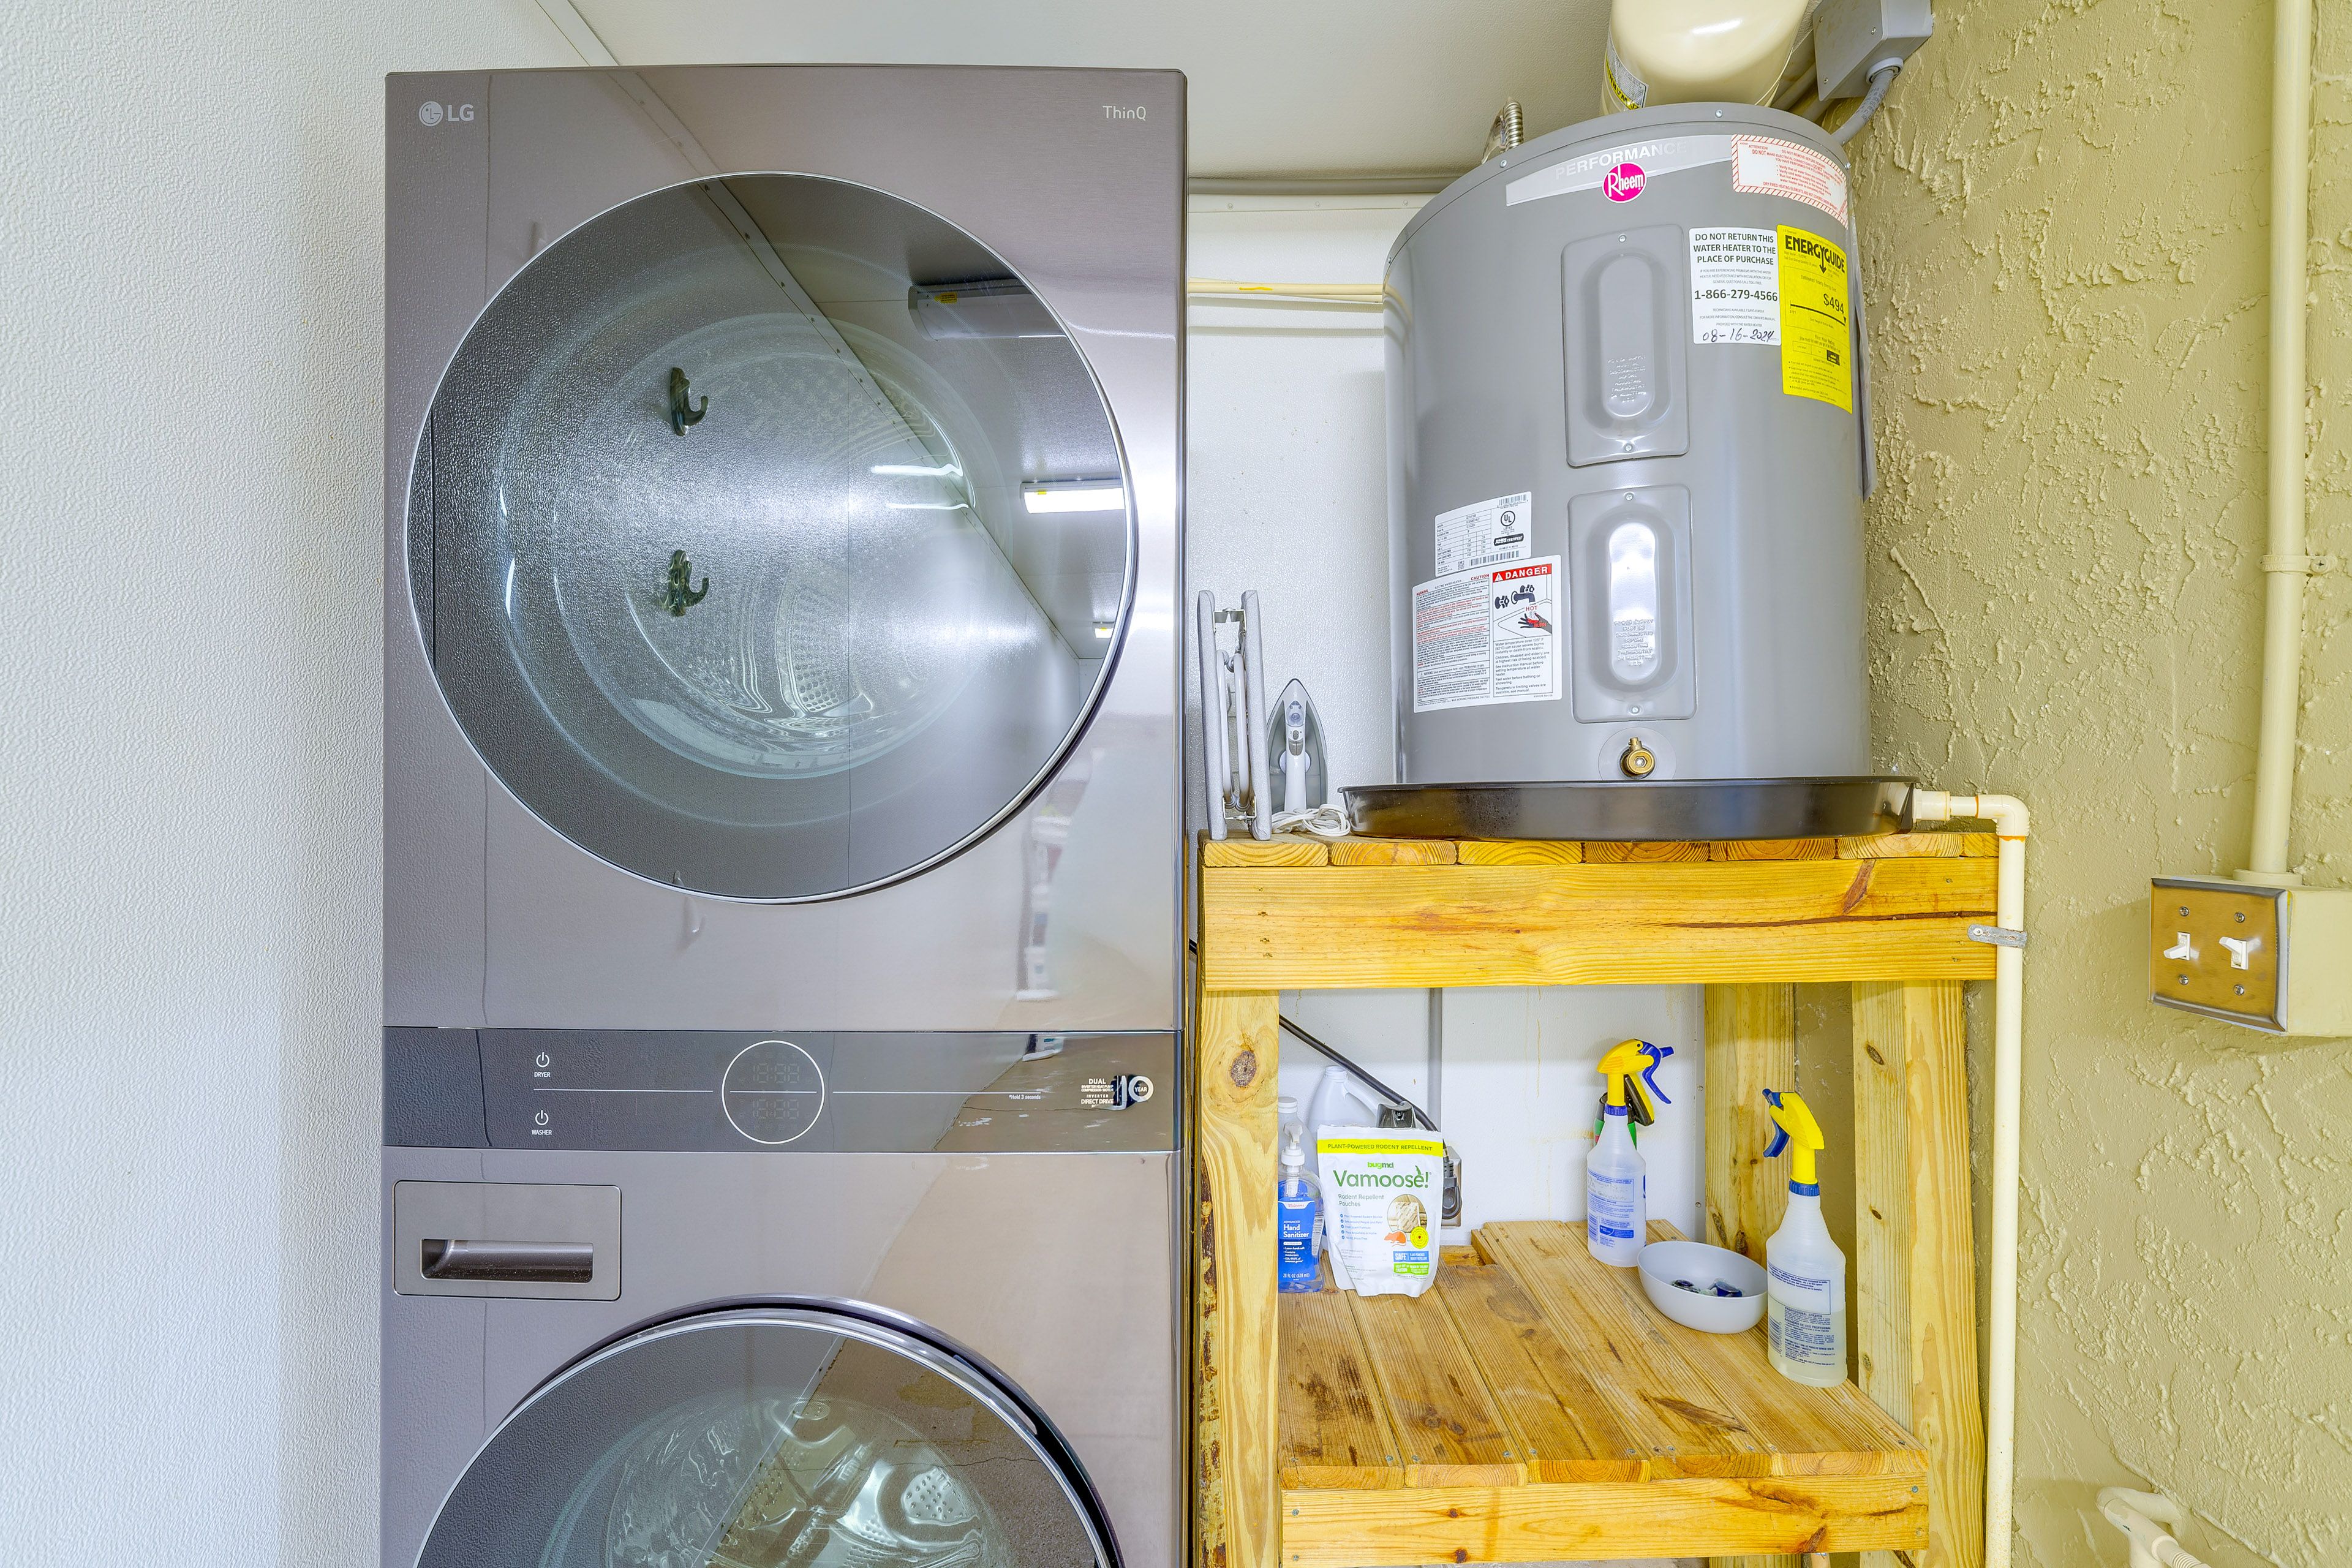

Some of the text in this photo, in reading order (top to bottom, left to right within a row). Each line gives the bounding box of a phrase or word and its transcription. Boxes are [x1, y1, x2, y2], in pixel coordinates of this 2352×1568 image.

[448, 104, 474, 121] LG
[1102, 105, 1147, 121] ThinQ
[1555, 141, 1687, 180] PERFORMANCE
[1607, 165, 1644, 197] Rheem
[1736, 255, 1774, 265] PURCHASE
[1785, 235, 1845, 274] ENERGYGUIDE
[1694, 289, 1778, 301] 1-866-279-4566
[1823, 293, 1844, 314] $494
[1504, 514, 1512, 523] UL
[1505, 566, 1548, 579] DANGER
[1785, 1307, 1807, 1316] PROFESSIONAL
